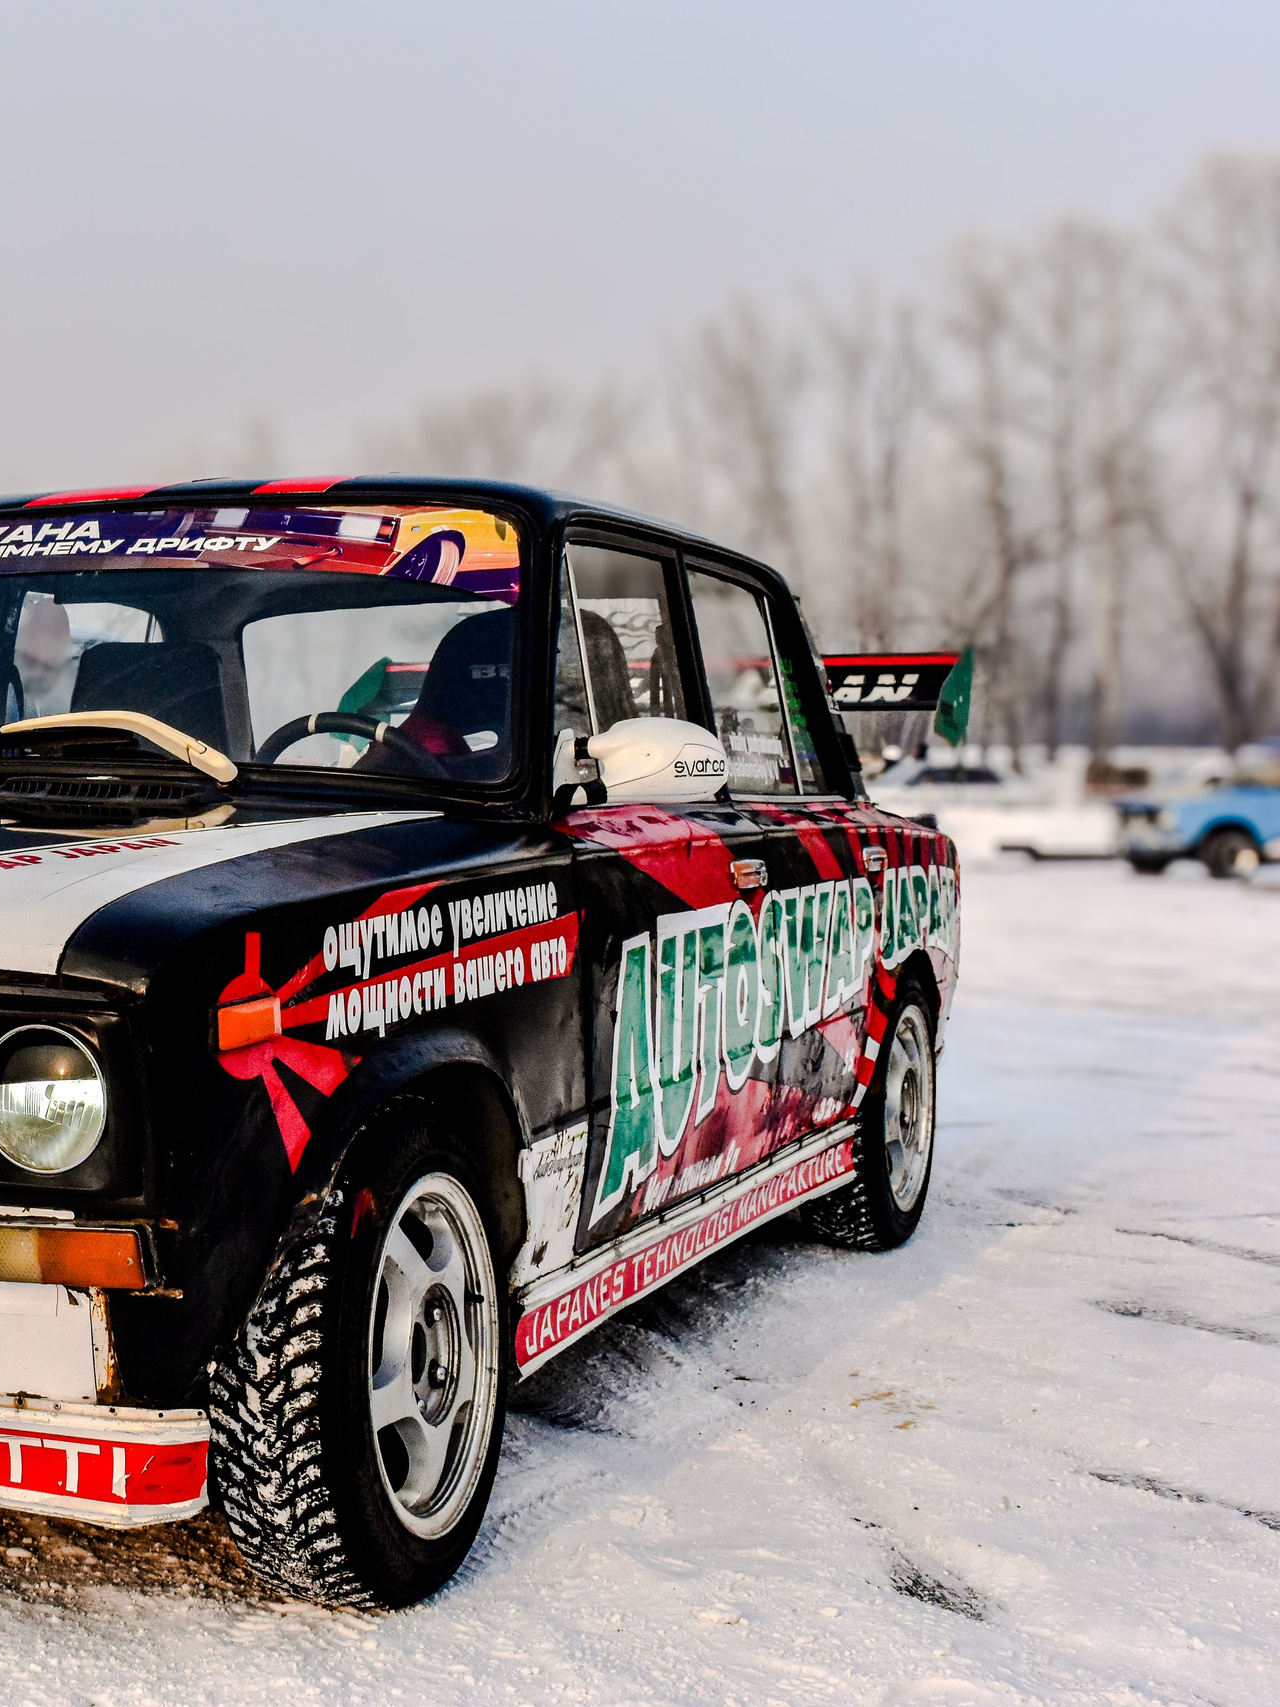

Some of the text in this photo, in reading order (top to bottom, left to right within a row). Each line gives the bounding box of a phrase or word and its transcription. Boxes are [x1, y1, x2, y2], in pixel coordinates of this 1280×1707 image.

[126, 537, 282, 555] ДРИФТУ
[51, 838, 183, 859] JAPAN
[448, 881, 557, 957] увеличение
[326, 936, 567, 1040] мощности вашего авто
[589, 877, 875, 1230] AUTOSWAP
[525, 1262, 626, 1356] JAPANES
[632, 1203, 735, 1290] TEHNOLOGI
[737, 1142, 845, 1228] MANUFAKTURE
